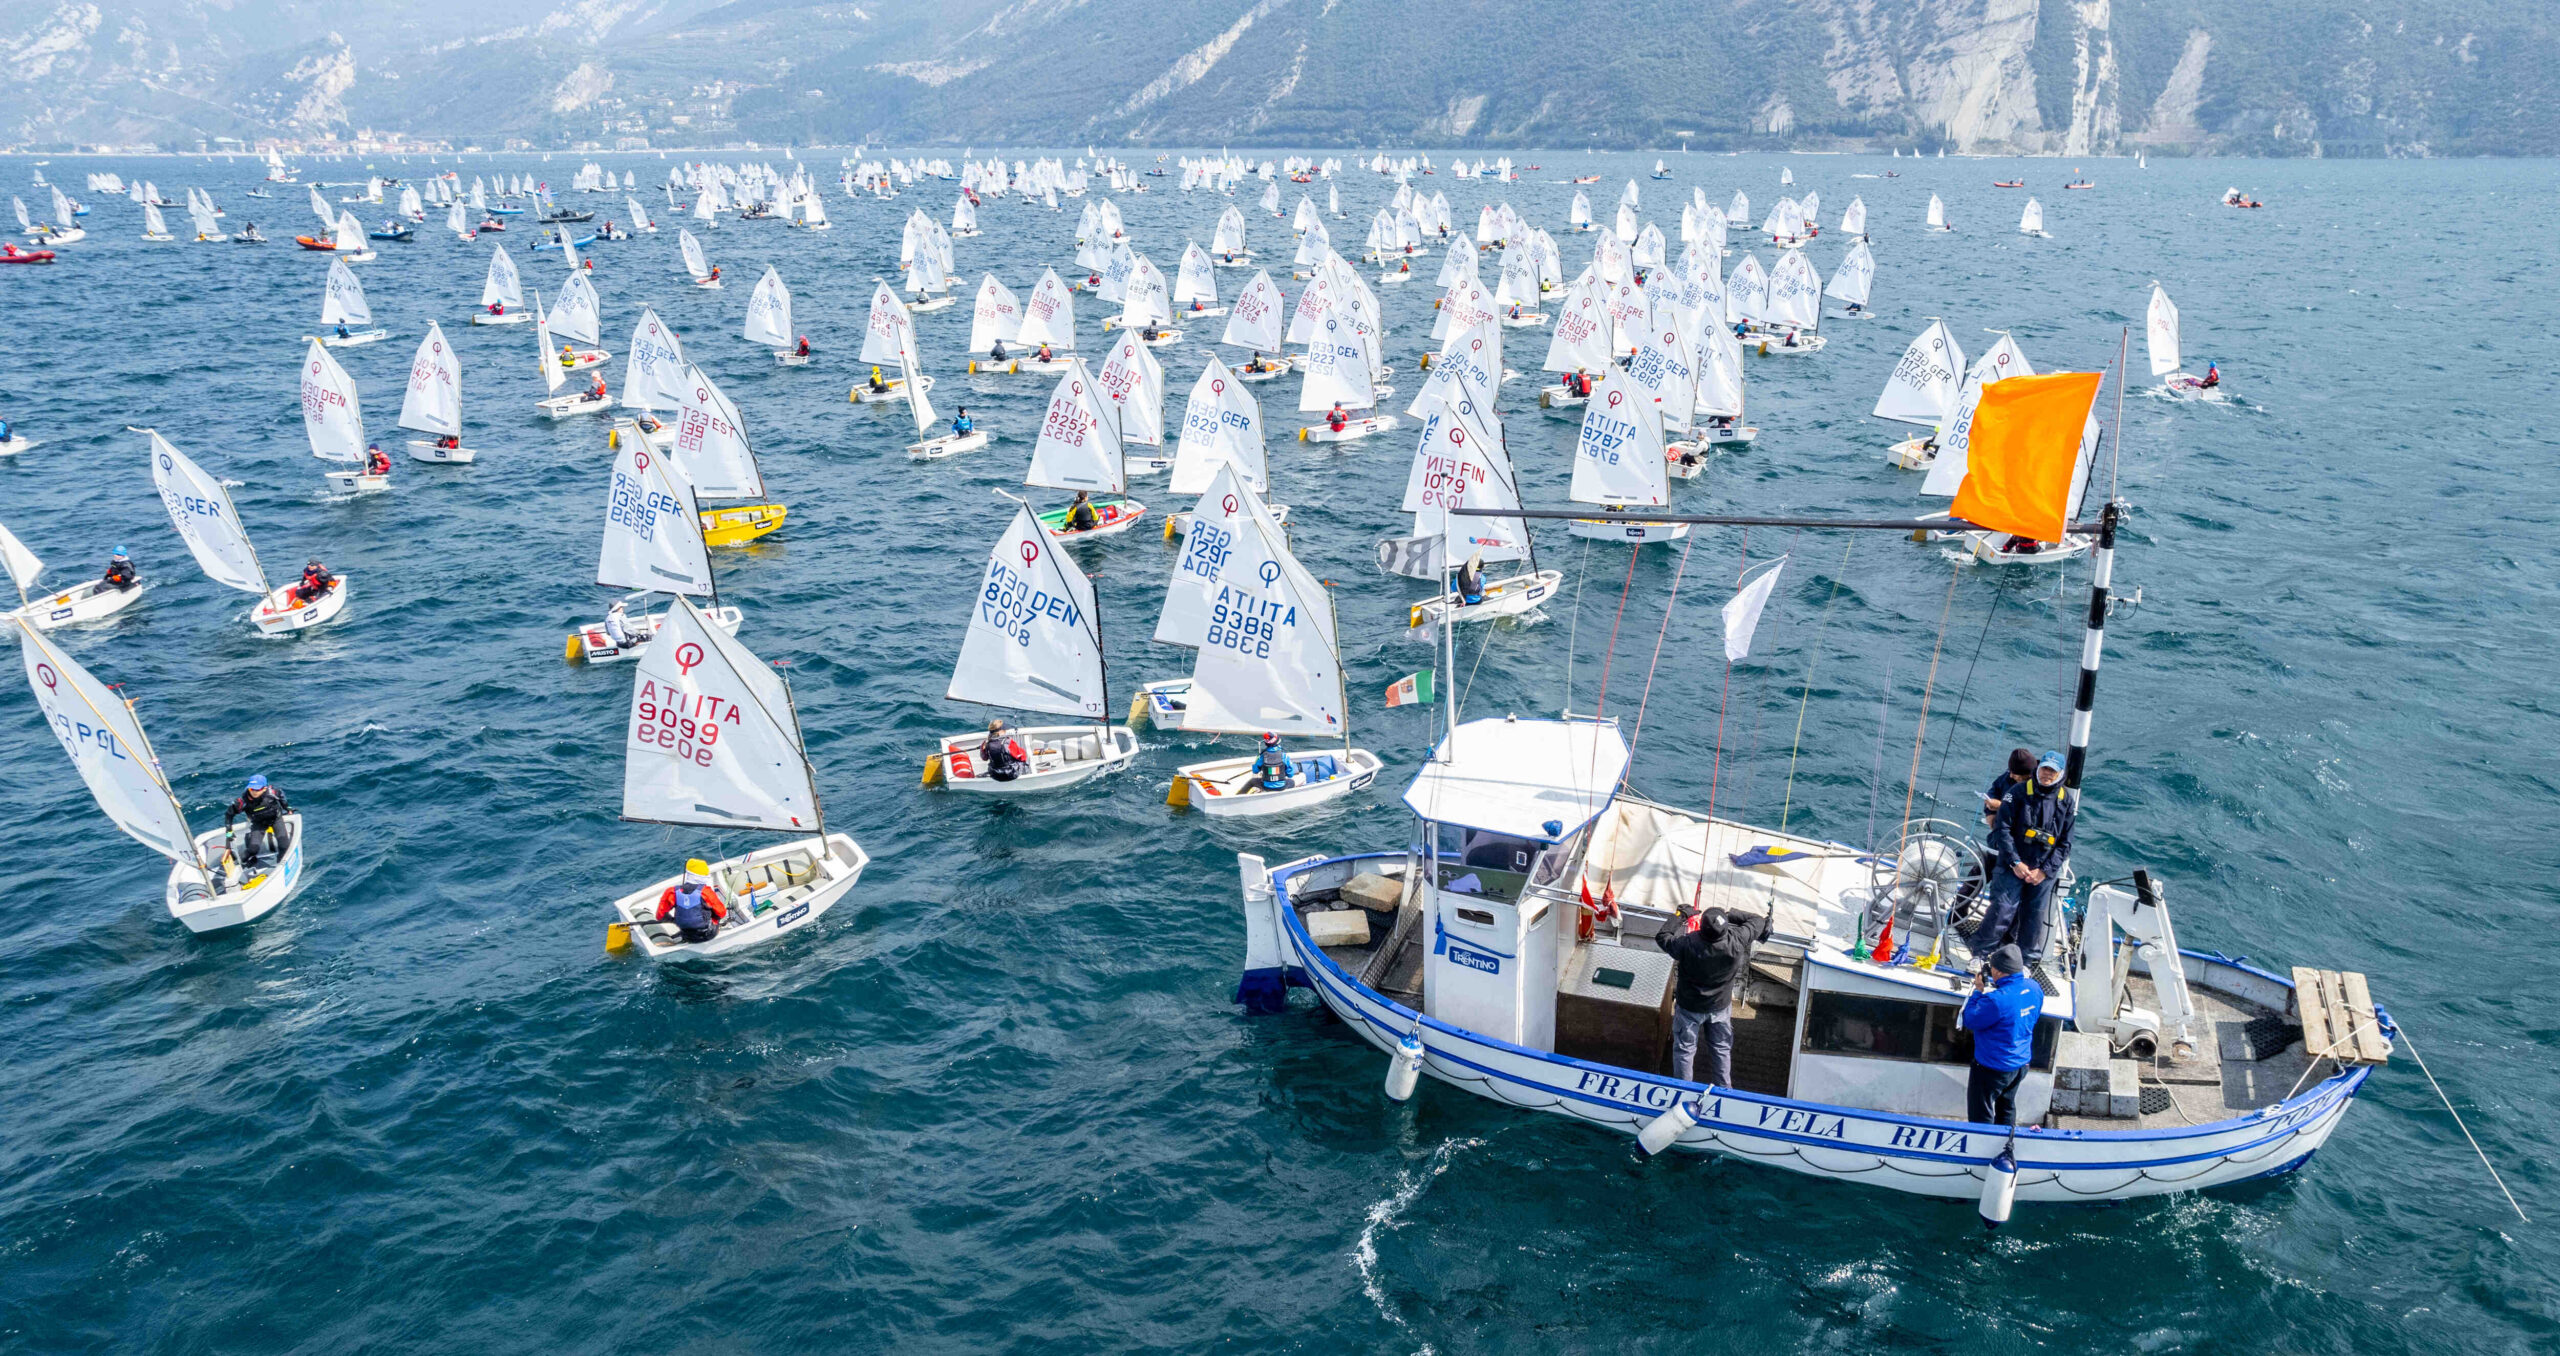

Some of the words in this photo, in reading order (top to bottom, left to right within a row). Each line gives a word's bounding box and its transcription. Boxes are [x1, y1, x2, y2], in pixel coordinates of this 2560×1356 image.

[1147, 282, 1162, 293] SWE
[1661, 289, 1678, 301] GER
[1703, 291, 1720, 303] GER
[1730, 280, 1751, 296] 13579
[1748, 281, 1763, 294] GER
[1800, 285, 1816, 296] GER
[996, 303, 1014, 314] GER
[1032, 298, 1055, 315] 9006
[1048, 297, 1061, 309] ITA
[1239, 299, 1262, 317] 9274
[1256, 298, 1269, 314] ITA
[1626, 305, 1644, 319] GRE
[1562, 319, 1589, 339] 7609
[1582, 319, 1597, 332] ITA
[634, 349, 657, 365] 1377
[657, 347, 676, 363] GER
[1310, 351, 1335, 365] 1223
[1337, 345, 1359, 359] GER
[413, 367, 431, 381] 1417
[436, 366, 451, 385] POL
[1469, 365, 1489, 388] POL
[1635, 355, 1666, 380] 13193
[1665, 359, 1689, 380] GER
[1901, 357, 1932, 382] 11730
[1930, 364, 1952, 384] GER
[1101, 371, 1132, 394] 9373
[1124, 369, 1142, 387] ITA
[302, 392, 324, 413] 8676
[321, 389, 346, 408] DEN
[712, 418, 735, 438] EST
[1050, 411, 1088, 436] 8252
[1078, 408, 1097, 430] ITA
[1186, 413, 1219, 434] 1829
[1221, 410, 1251, 431] GER
[681, 420, 705, 439] 139
[1582, 426, 1623, 449] 9787
[1613, 420, 1636, 440] ITA
[1424, 472, 1465, 494] 1079
[1460, 462, 1485, 485] FIN
[184, 496, 220, 517] GER
[647, 491, 684, 517] GER
[984, 582, 1038, 627] 8007
[1031, 590, 1080, 628] DEN
[1260, 600, 1296, 628] ITA
[1212, 603, 1274, 641] 9388
[591, 649, 615, 657] MUSTO
[694, 694, 741, 725] ITA
[638, 702, 719, 746] 9099
[76, 722, 126, 760] POL
[1452, 950, 1496, 970] TRENTINO
[1758, 1105, 1845, 1139] VELA
[1889, 1125, 1969, 1154] RIVA
